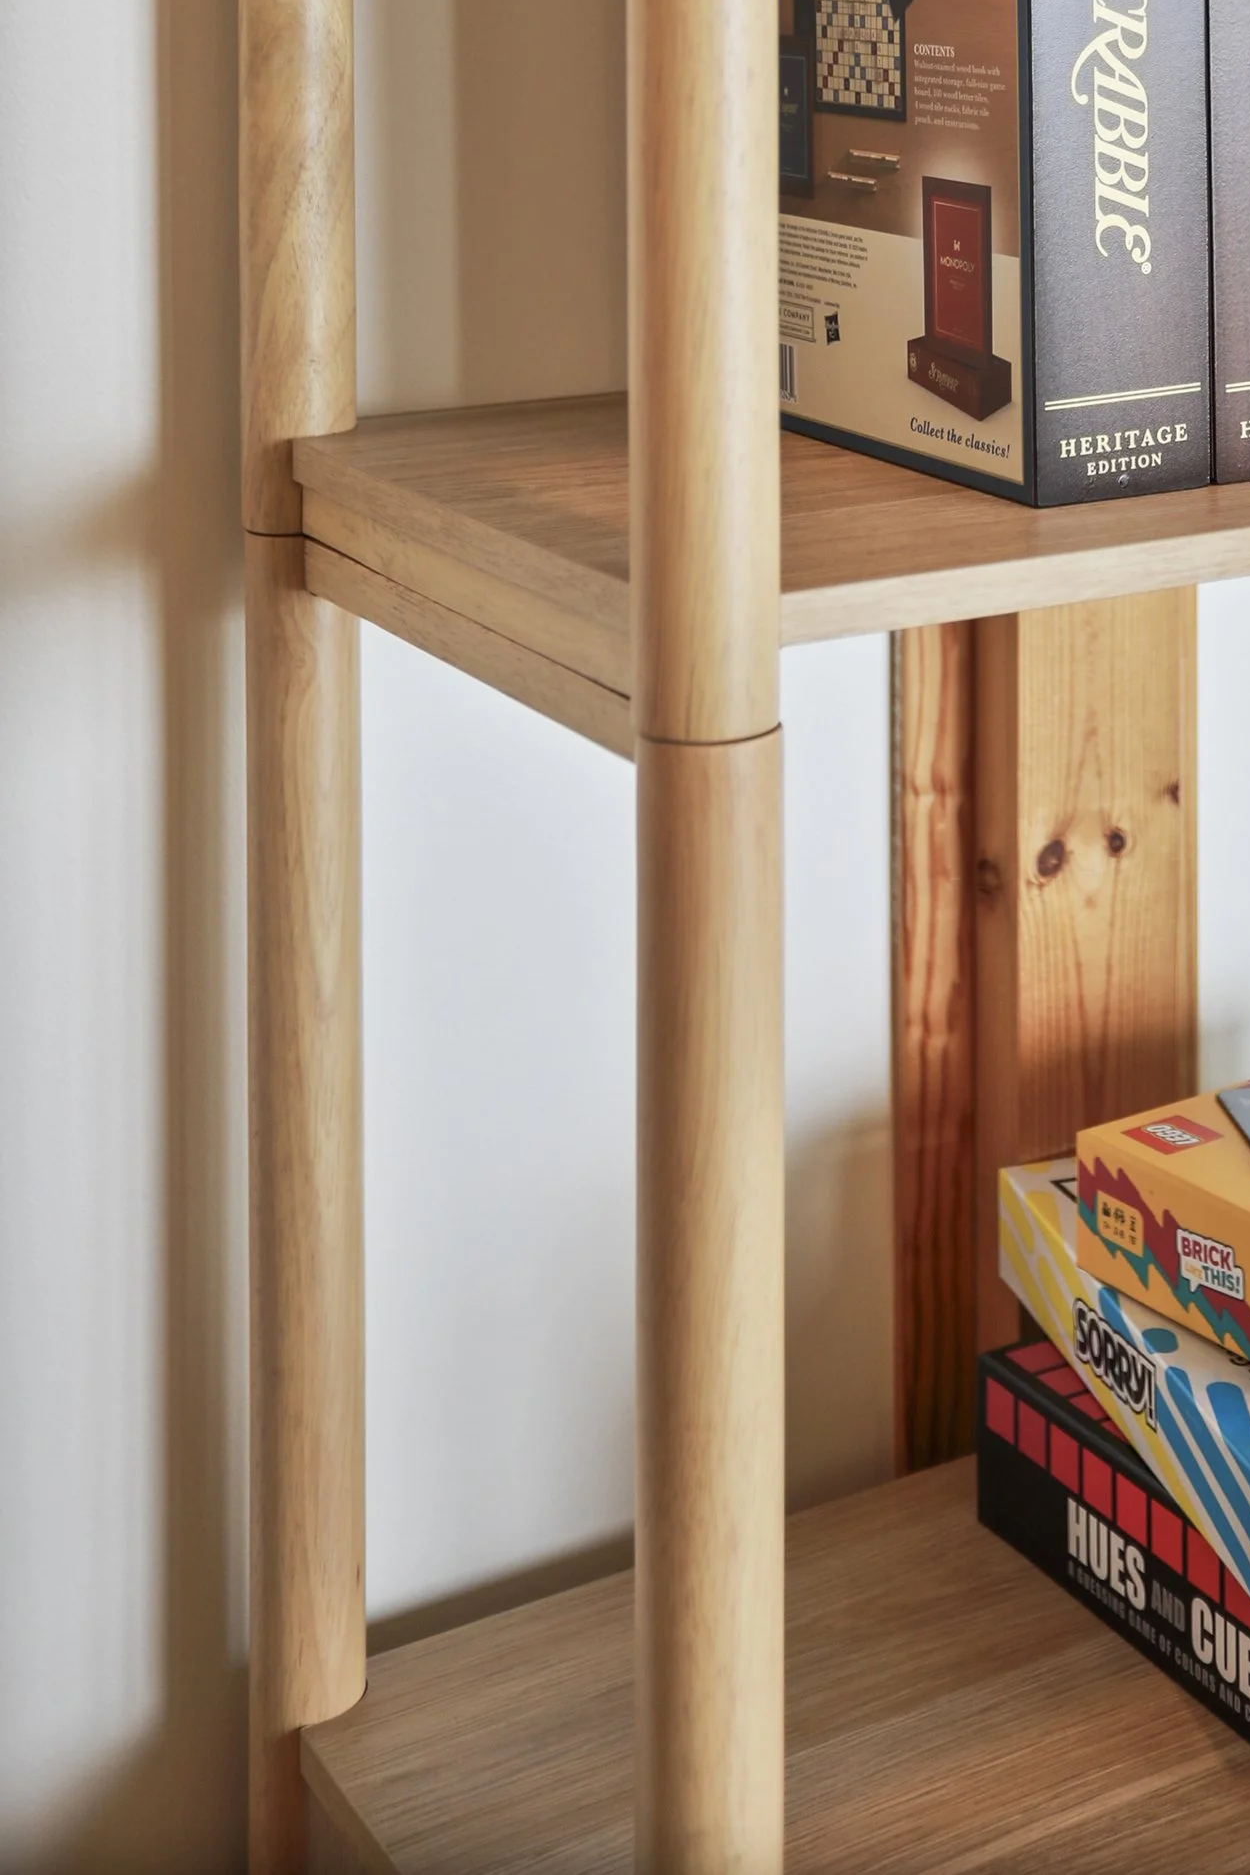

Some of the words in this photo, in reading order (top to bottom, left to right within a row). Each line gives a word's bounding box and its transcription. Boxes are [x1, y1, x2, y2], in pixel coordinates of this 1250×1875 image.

[914, 43, 955, 58] CONTENTS
[956, 64, 971, 73] wood
[987, 66, 1000, 76] with
[914, 74, 942, 84] integrated
[989, 83, 1006, 92] game
[919, 101, 933, 111] wood
[934, 103, 943, 112] tile
[943, 90, 958, 99] wood
[959, 91, 973, 101] letter
[933, 117, 944, 125] and
[783, 309, 810, 322] COMPANY
[910, 416, 944, 441] Collect
[947, 427, 962, 445] the
[965, 432, 1010, 458] classics!
[1059, 423, 1188, 459] HERITAGE
[1086, 451, 1163, 477] EDITION
[1142, 1123, 1200, 1146] LEGO
[1181, 1236, 1232, 1271] BRICK
[1201, 1265, 1240, 1294] THIS!
[1074, 1301, 1156, 1430] SORRY!
[1067, 1496, 1146, 1611] HUES
[1151, 1579, 1185, 1632] AND
[1077, 1563, 1126, 1621] GUESSING
[1128, 1611, 1156, 1644] GAME
[1159, 1636, 1171, 1657] OF
[1175, 1646, 1216, 1694] COLORS
[1219, 1684, 1241, 1713] AND
